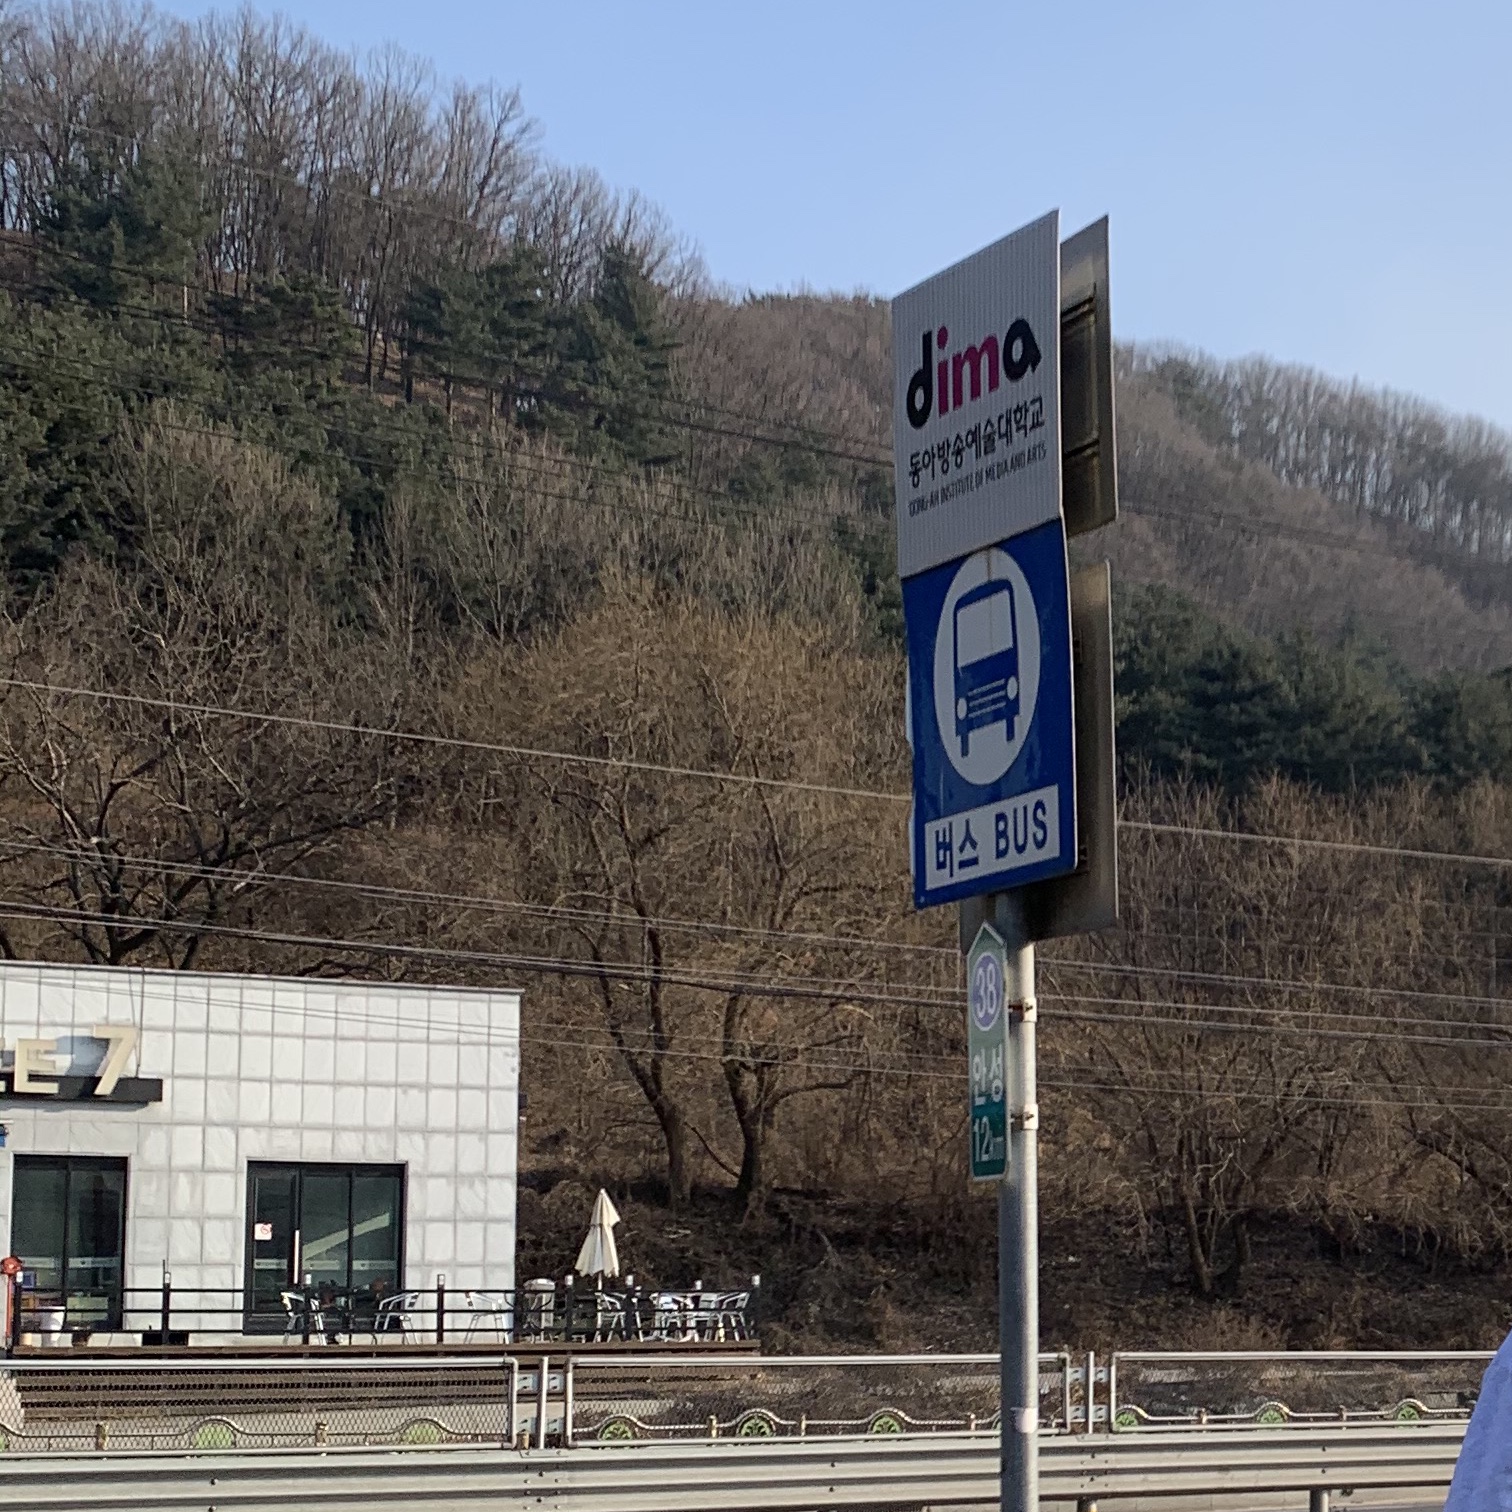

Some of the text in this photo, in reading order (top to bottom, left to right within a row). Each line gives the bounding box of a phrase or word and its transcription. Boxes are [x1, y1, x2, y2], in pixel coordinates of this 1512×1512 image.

[906, 318, 1042, 430] dima
[909, 395, 1045, 488] 동아방송예술대학교
[935, 799, 1048, 878] 버스 BUS
[976, 963, 998, 1018] 38
[972, 1045, 1004, 1106] 안성
